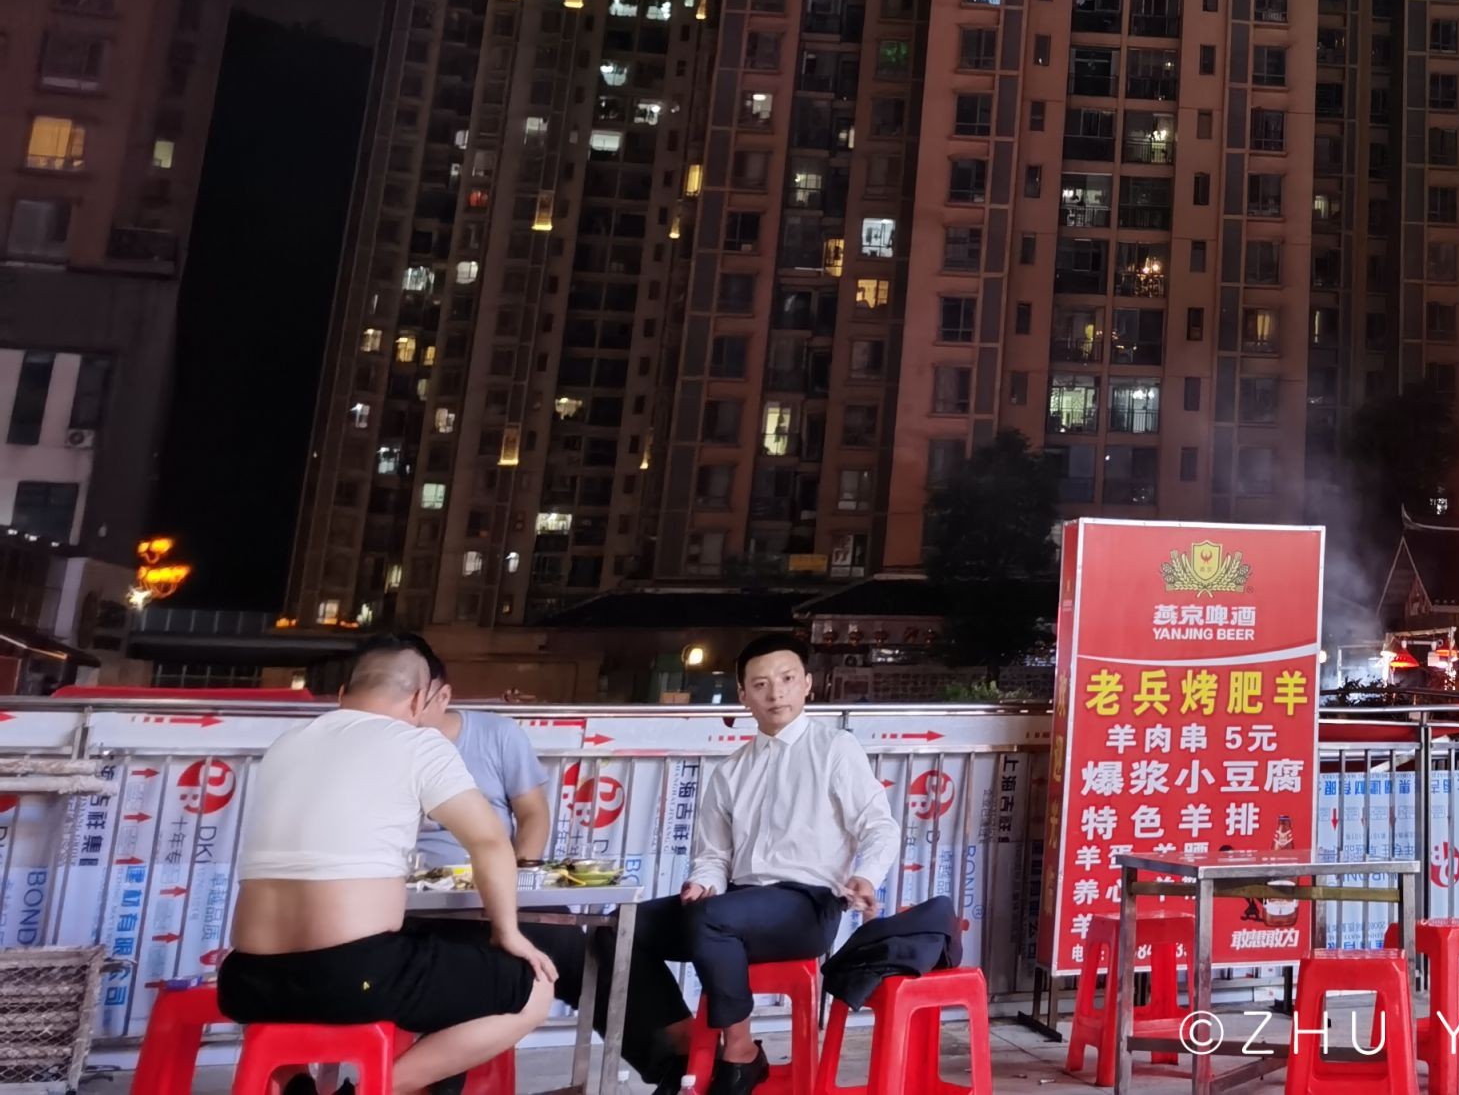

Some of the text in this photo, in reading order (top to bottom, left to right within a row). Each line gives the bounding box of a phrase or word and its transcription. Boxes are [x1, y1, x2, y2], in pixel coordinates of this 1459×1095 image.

[1153, 604, 1256, 627] 燕京啤酒
[1152, 627, 1255, 641] YANJING BEER
[1085, 668, 1308, 717] 老兵烤肥羊
[1105, 724, 1278, 754] 羊肉串 5元
[1081, 758, 1304, 797] 爆浆小豆腐
[1081, 803, 1260, 841] 特色羊排
[1230, 927, 1300, 951] 敢想敢为
